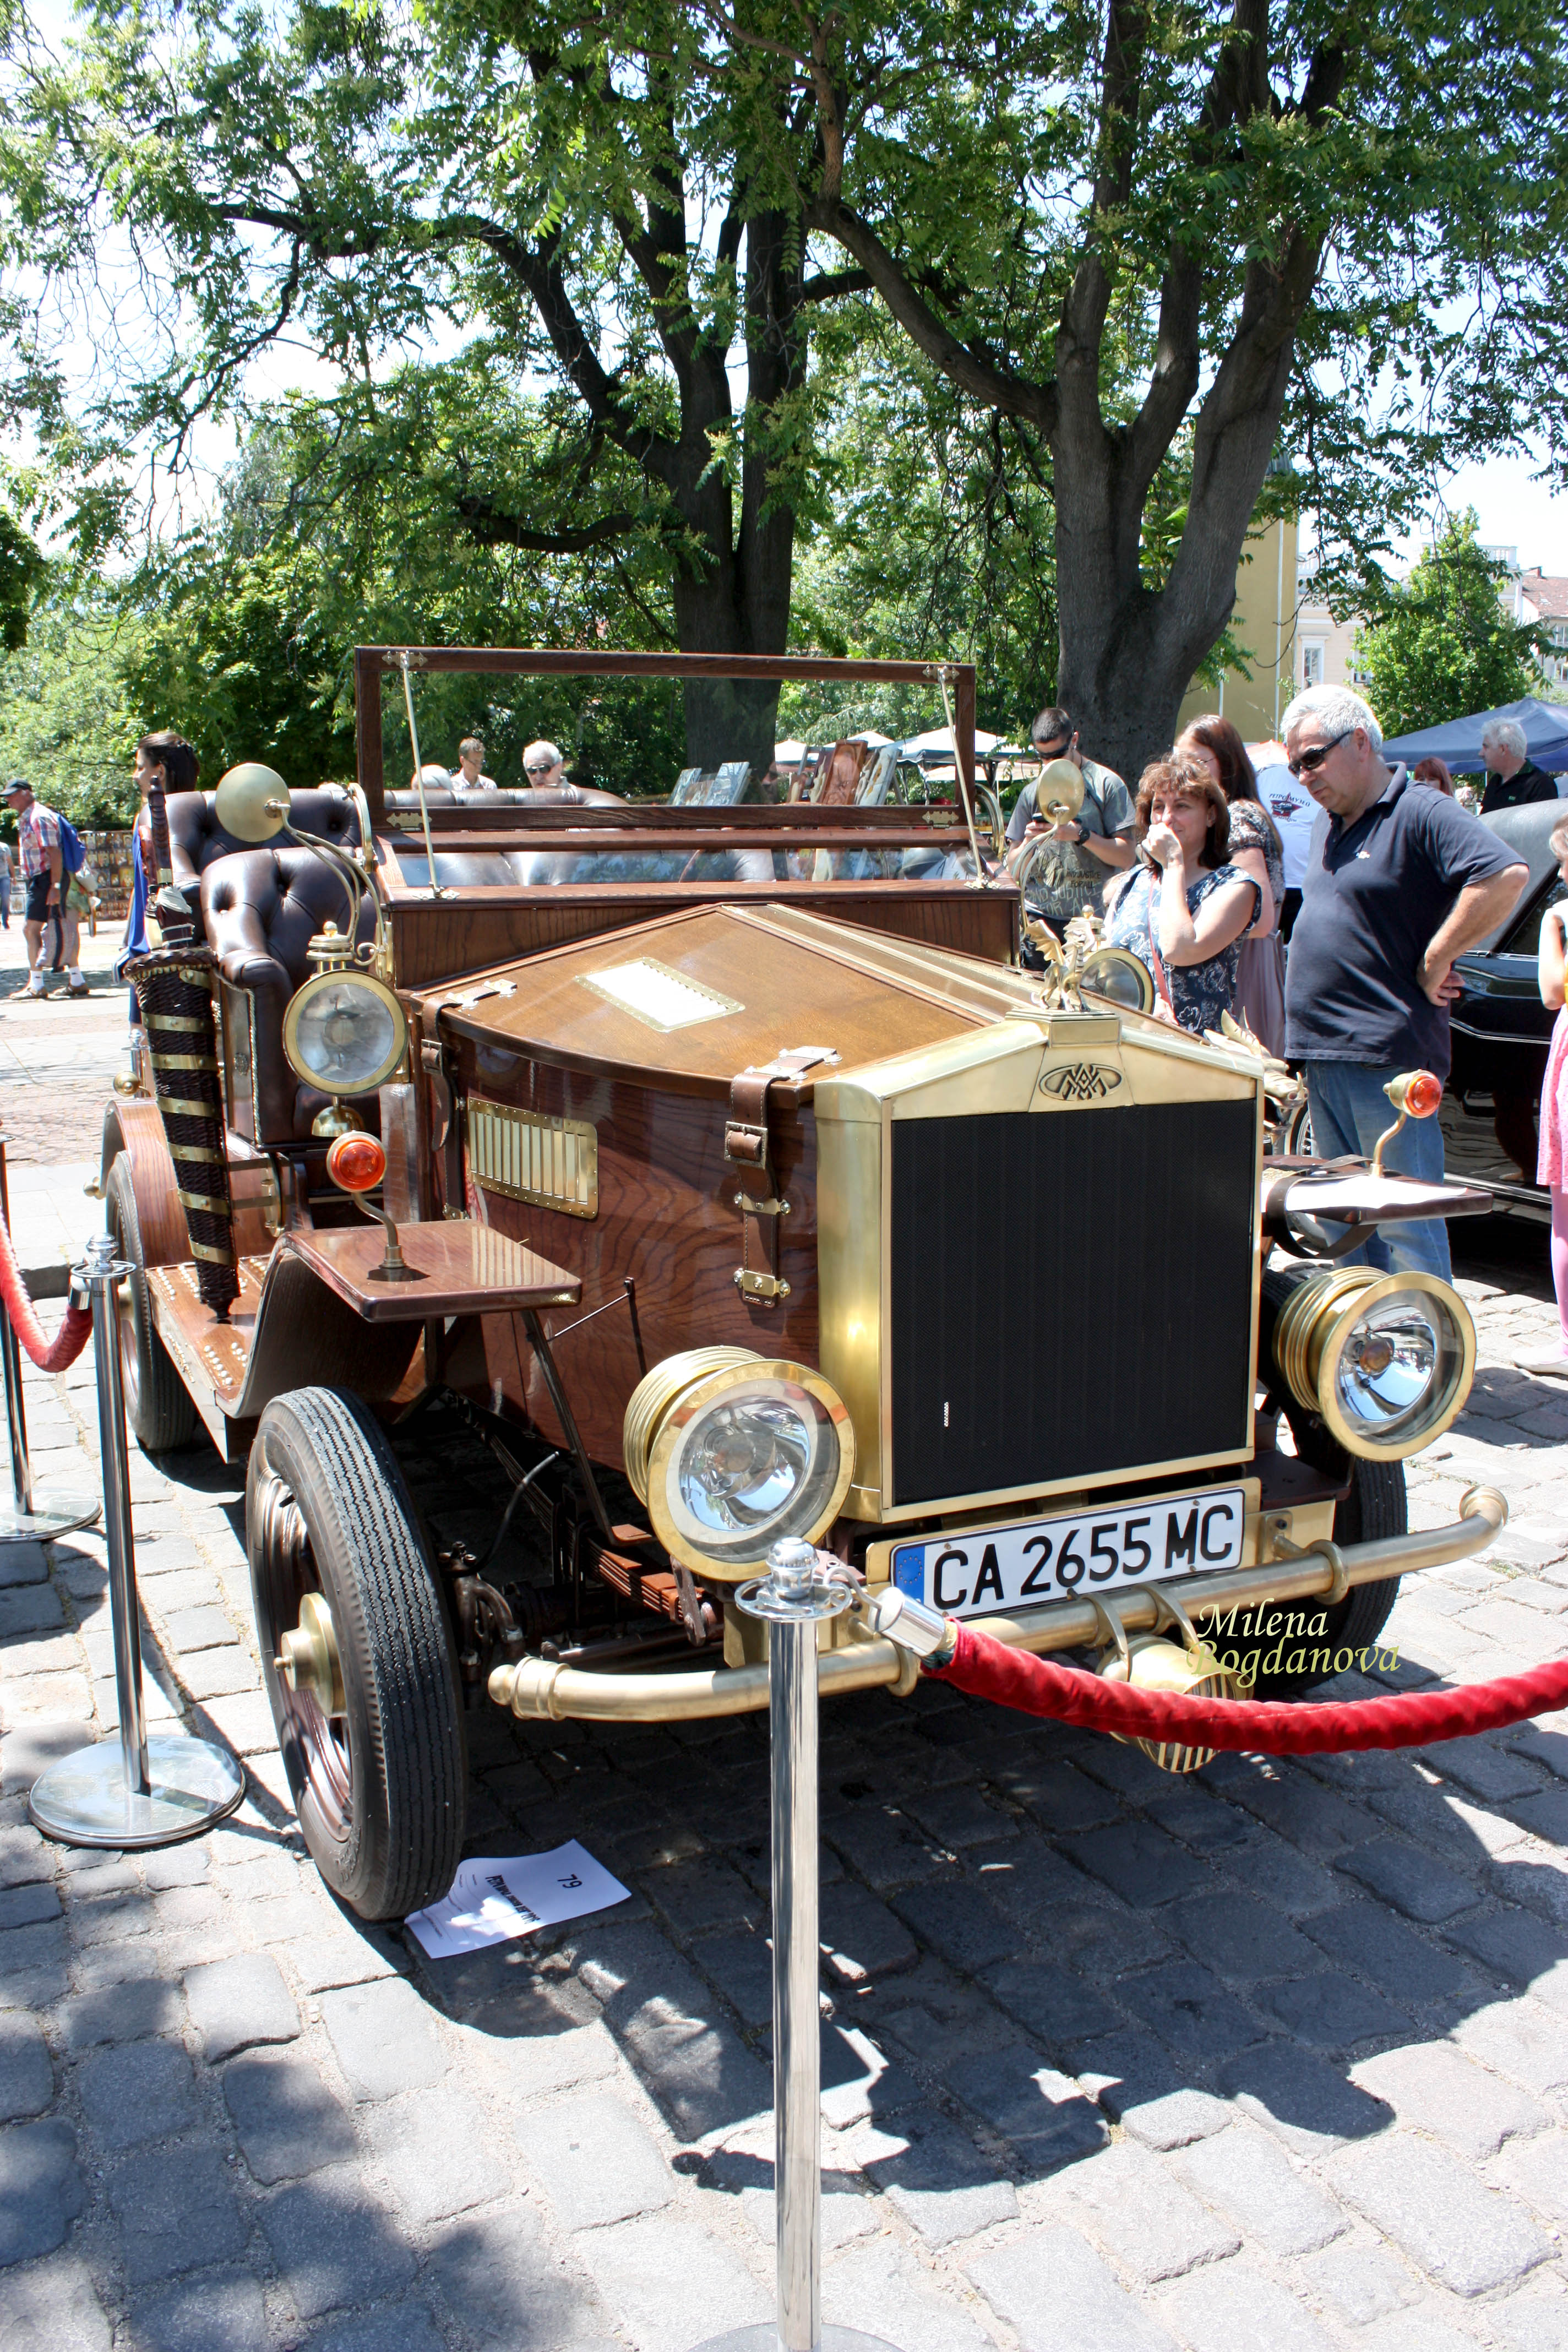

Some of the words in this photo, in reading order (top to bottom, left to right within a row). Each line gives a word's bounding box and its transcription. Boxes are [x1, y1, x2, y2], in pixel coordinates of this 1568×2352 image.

[933, 1543, 1004, 1610] CA
[1021, 1517, 1151, 1596] 2655
[1164, 1504, 1233, 1569] MC
[557, 1874, 582, 1888] 79
